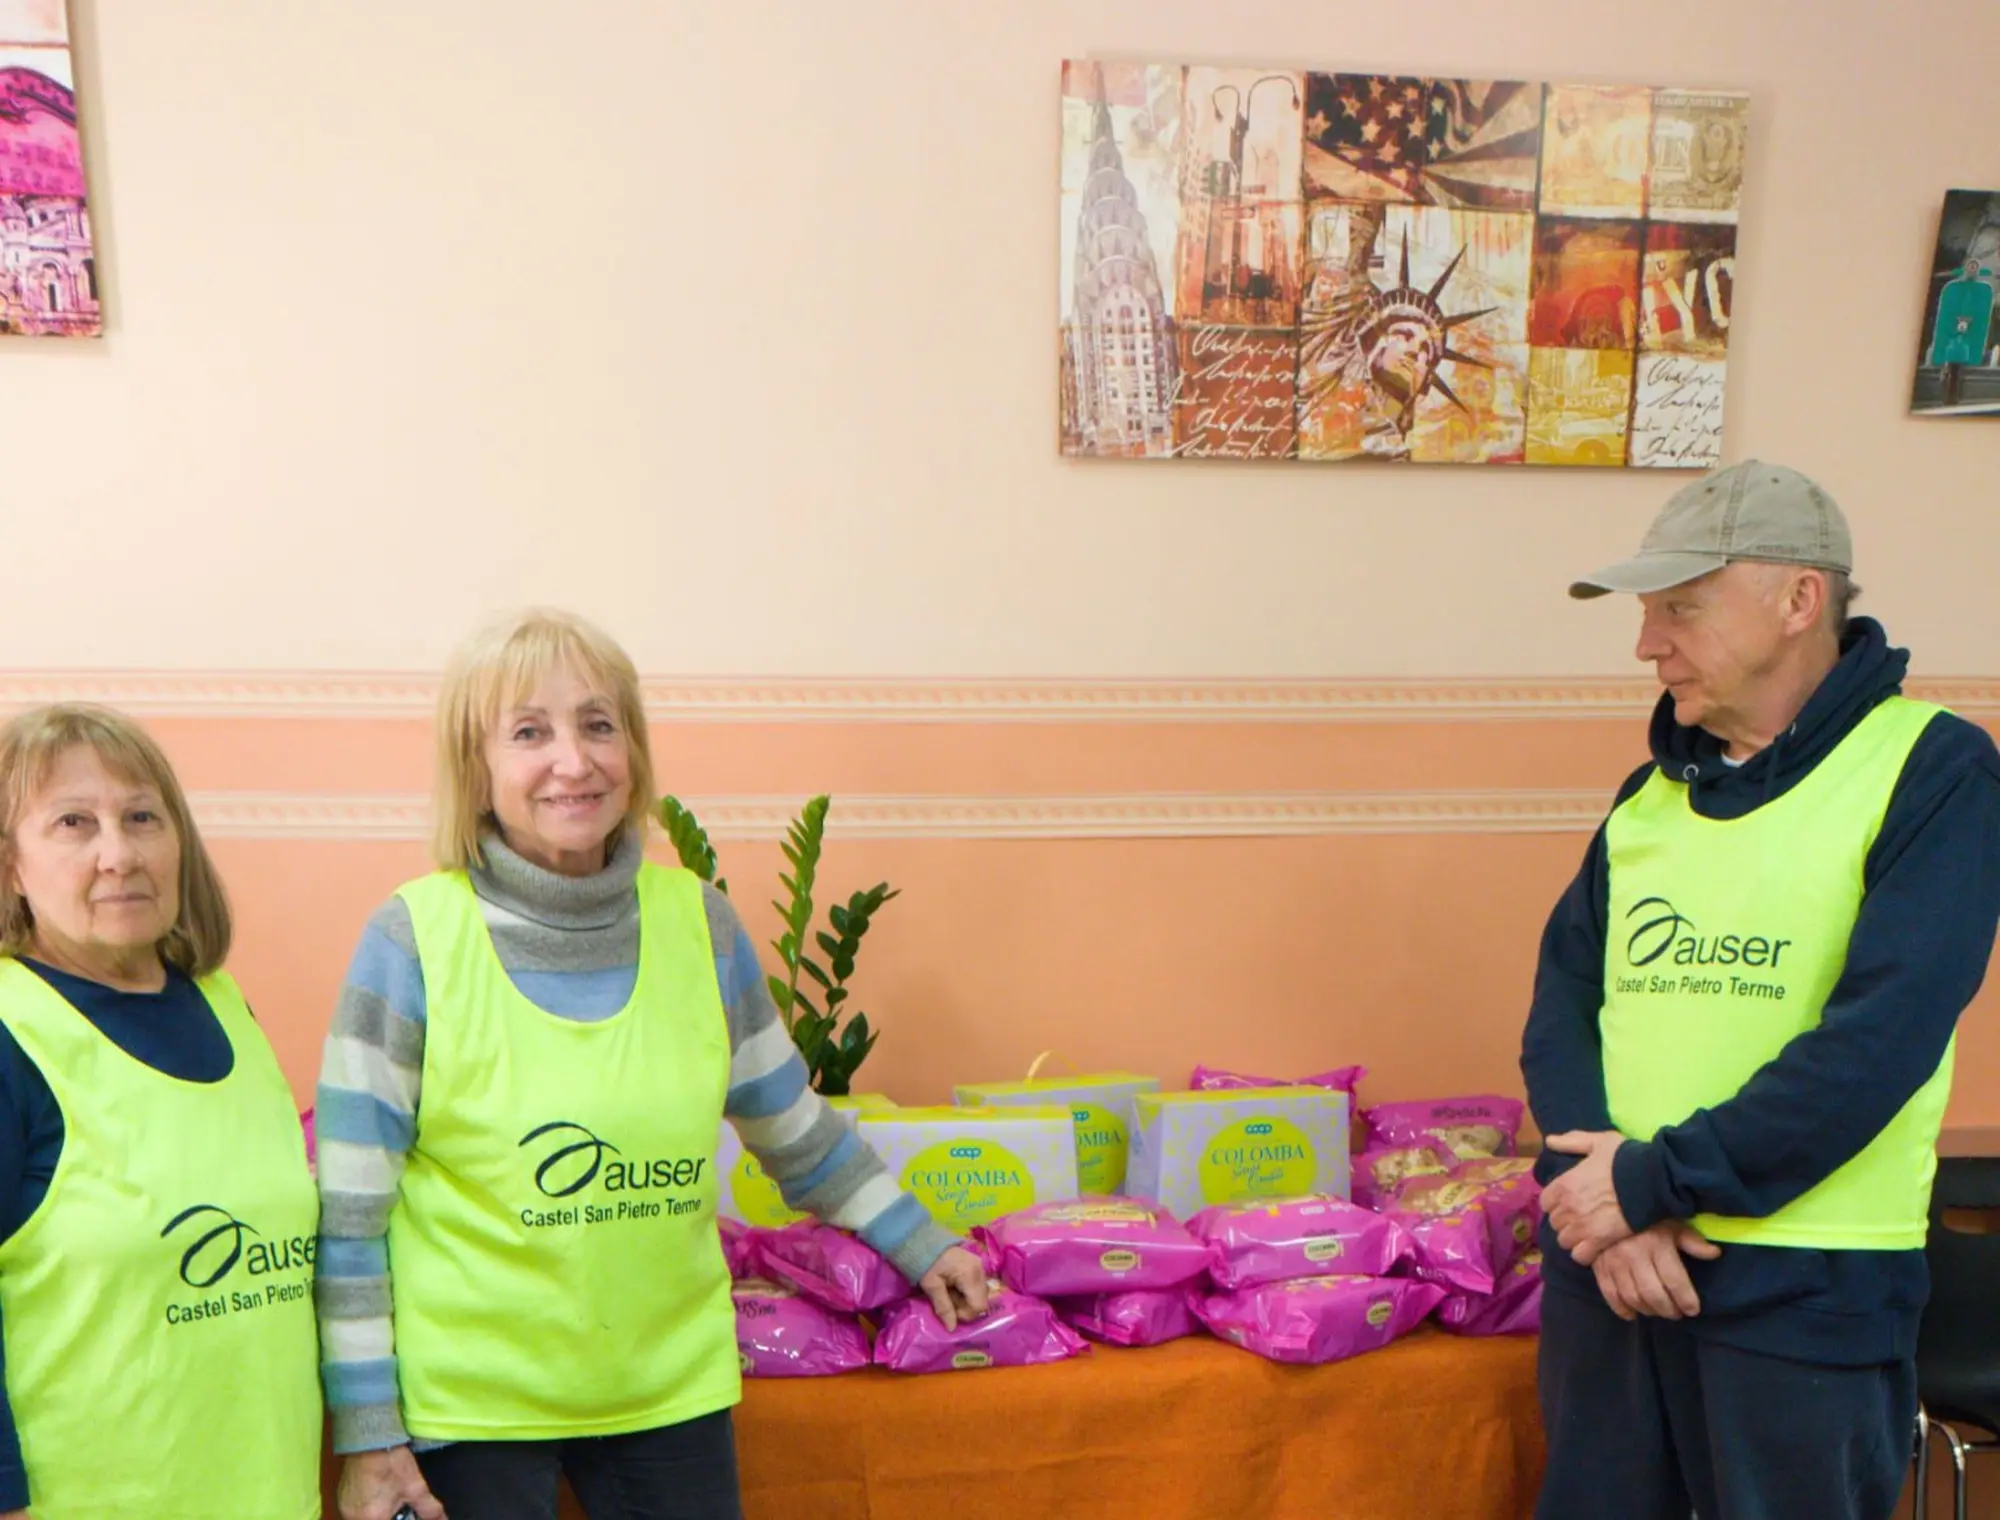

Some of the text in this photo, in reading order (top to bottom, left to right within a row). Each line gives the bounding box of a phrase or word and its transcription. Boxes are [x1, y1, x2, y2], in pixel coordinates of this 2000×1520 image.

[1674, 934, 1792, 968] auser
[1650, 975, 1676, 994] San
[1679, 976, 1722, 995] Pietro
[1729, 976, 1786, 1001] Terme
[1211, 1143, 1305, 1166] COLOMBA
[604, 1157, 706, 1192] auser
[911, 1169, 1021, 1188] COLOMBA
[520, 1198, 702, 1228] Castel San Pietro Terme
[246, 1233, 317, 1276] ause
[166, 1294, 227, 1326] Castel
[231, 1291, 263, 1312] San
[266, 1284, 304, 1305] Pietro
